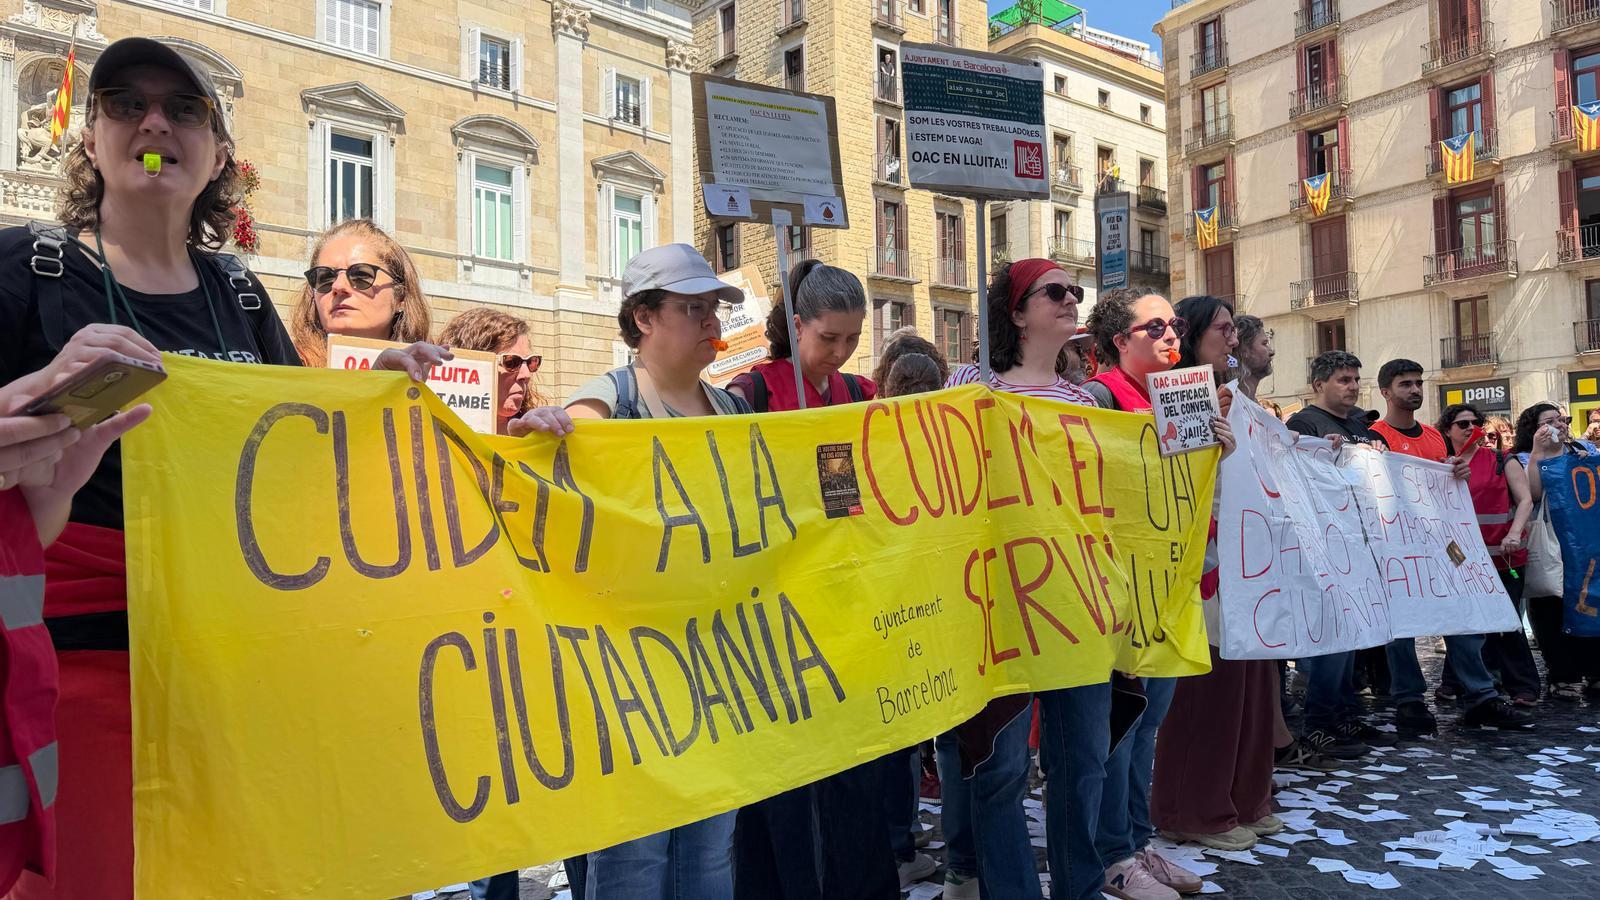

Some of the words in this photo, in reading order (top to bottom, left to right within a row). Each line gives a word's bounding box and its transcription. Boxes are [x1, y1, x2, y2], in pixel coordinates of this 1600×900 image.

[904, 53, 949, 66] AJUNTAMENT
[952, 60, 962, 68] DE
[963, 60, 1001, 74] Barcelona
[995, 89, 1006, 98] joc
[909, 116, 929, 126] SOM
[931, 117, 945, 127] LES
[946, 119, 981, 130] VOSTRES
[915, 132, 944, 142] ESTEM
[946, 134, 957, 143] DE
[958, 136, 983, 146] VAGA!
[911, 151, 941, 164] OAC
[943, 153, 961, 165] EN
[964, 155, 1008, 169] LLUITA!!
[344, 356, 370, 371] OA
[732, 348, 762, 363] RECURSOS
[1153, 376, 1170, 389] OAC
[437, 393, 490, 410] TAMBÉ
[1159, 383, 1210, 405] RECTIFICACIÓ
[1464, 386, 1505, 403] pans
[1163, 403, 1179, 418] DEL
[862, 398, 1063, 527] CUIDEM
[1058, 413, 1115, 518] EL
[1140, 422, 1197, 533] OA
[652, 435, 712, 574] A
[705, 422, 798, 558] LA
[873, 594, 943, 640] ajuntament
[907, 639, 923, 659] de
[876, 667, 958, 725] Barcelona
